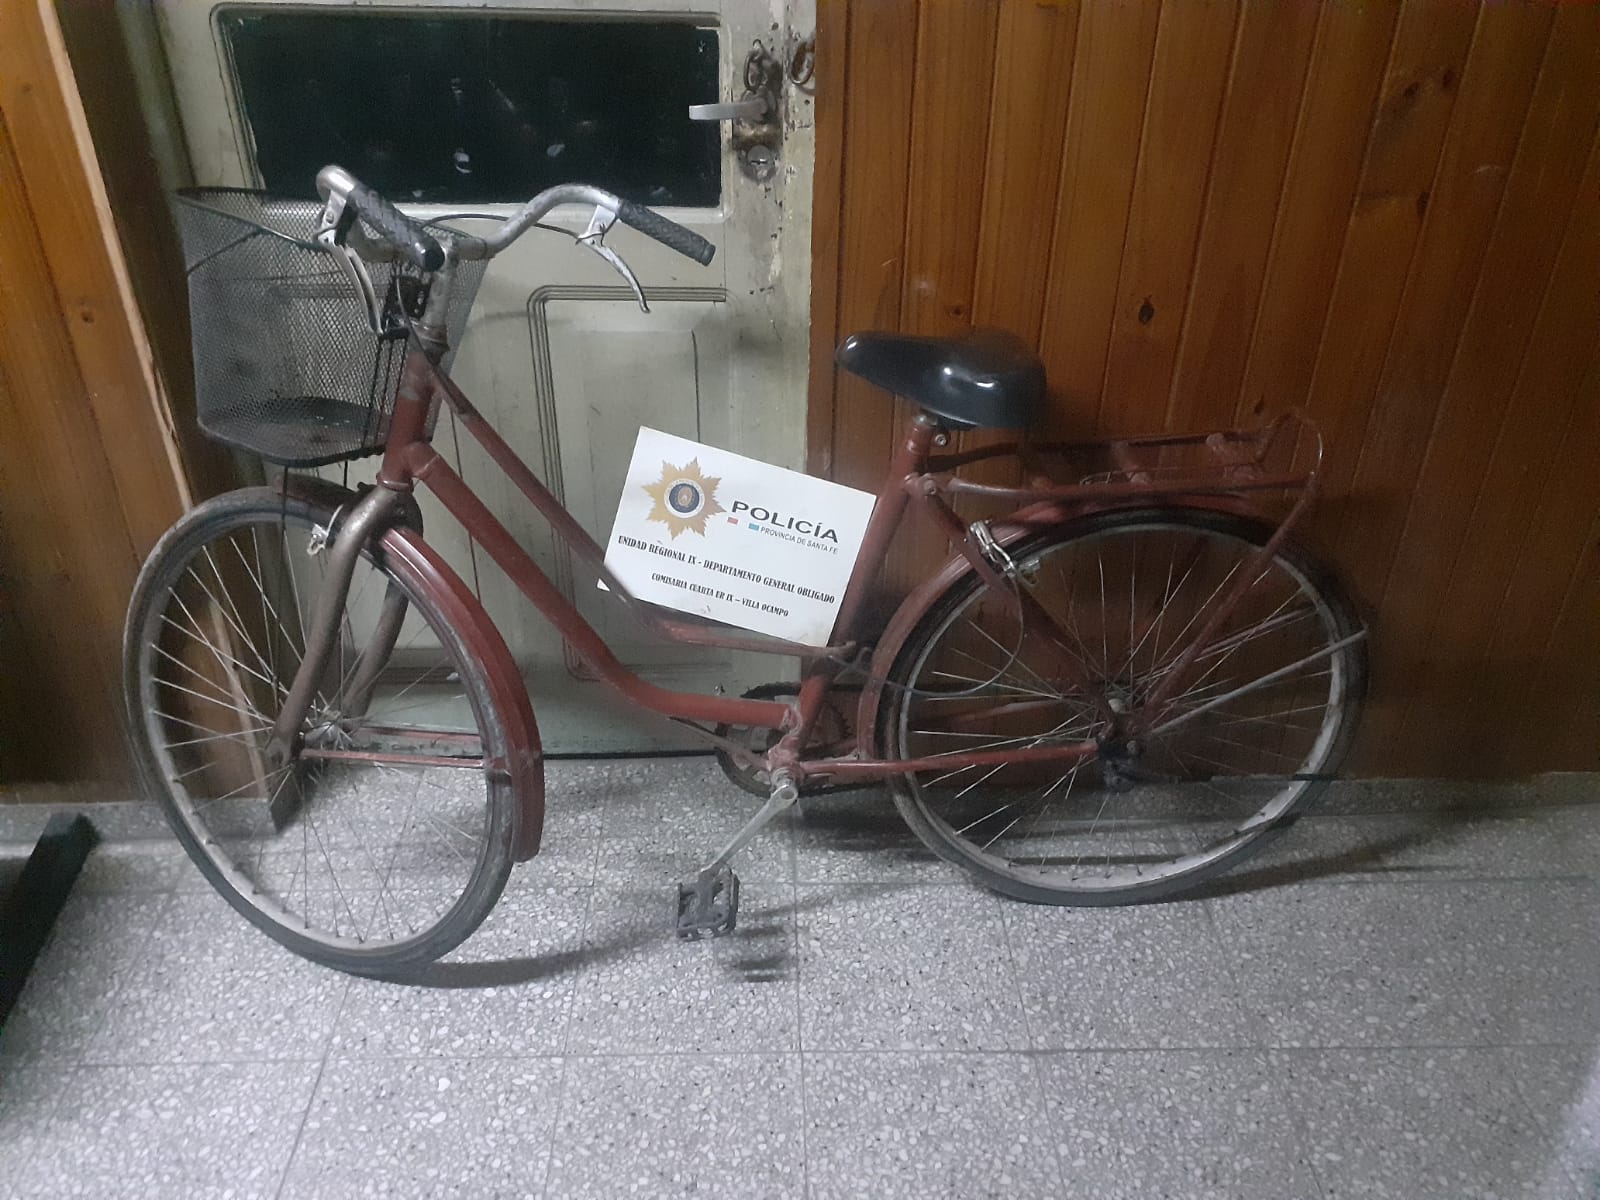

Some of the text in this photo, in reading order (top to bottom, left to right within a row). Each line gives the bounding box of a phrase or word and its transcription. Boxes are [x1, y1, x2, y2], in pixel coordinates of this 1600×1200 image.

[732, 500, 838, 543] POLICÍA
[761, 527, 796, 543] PROVINCIA
[797, 537, 806, 545] DE
[807, 540, 828, 552] SANTA
[618, 535, 647, 550] UNIDAD
[648, 543, 686, 562] REGIONAL
[688, 555, 697, 565] IX
[703, 559, 762, 583] DEPARTAMENTO
[763, 576, 796, 593] GENERAL
[797, 586, 835, 604] OBLIGADO
[651, 573, 687, 589] COMISARIA
[689, 583, 714, 597] CUARTA
[726, 594, 734, 603] IX
[742, 598, 760, 609] VILLA
[761, 603, 789, 617] OCAMPO
